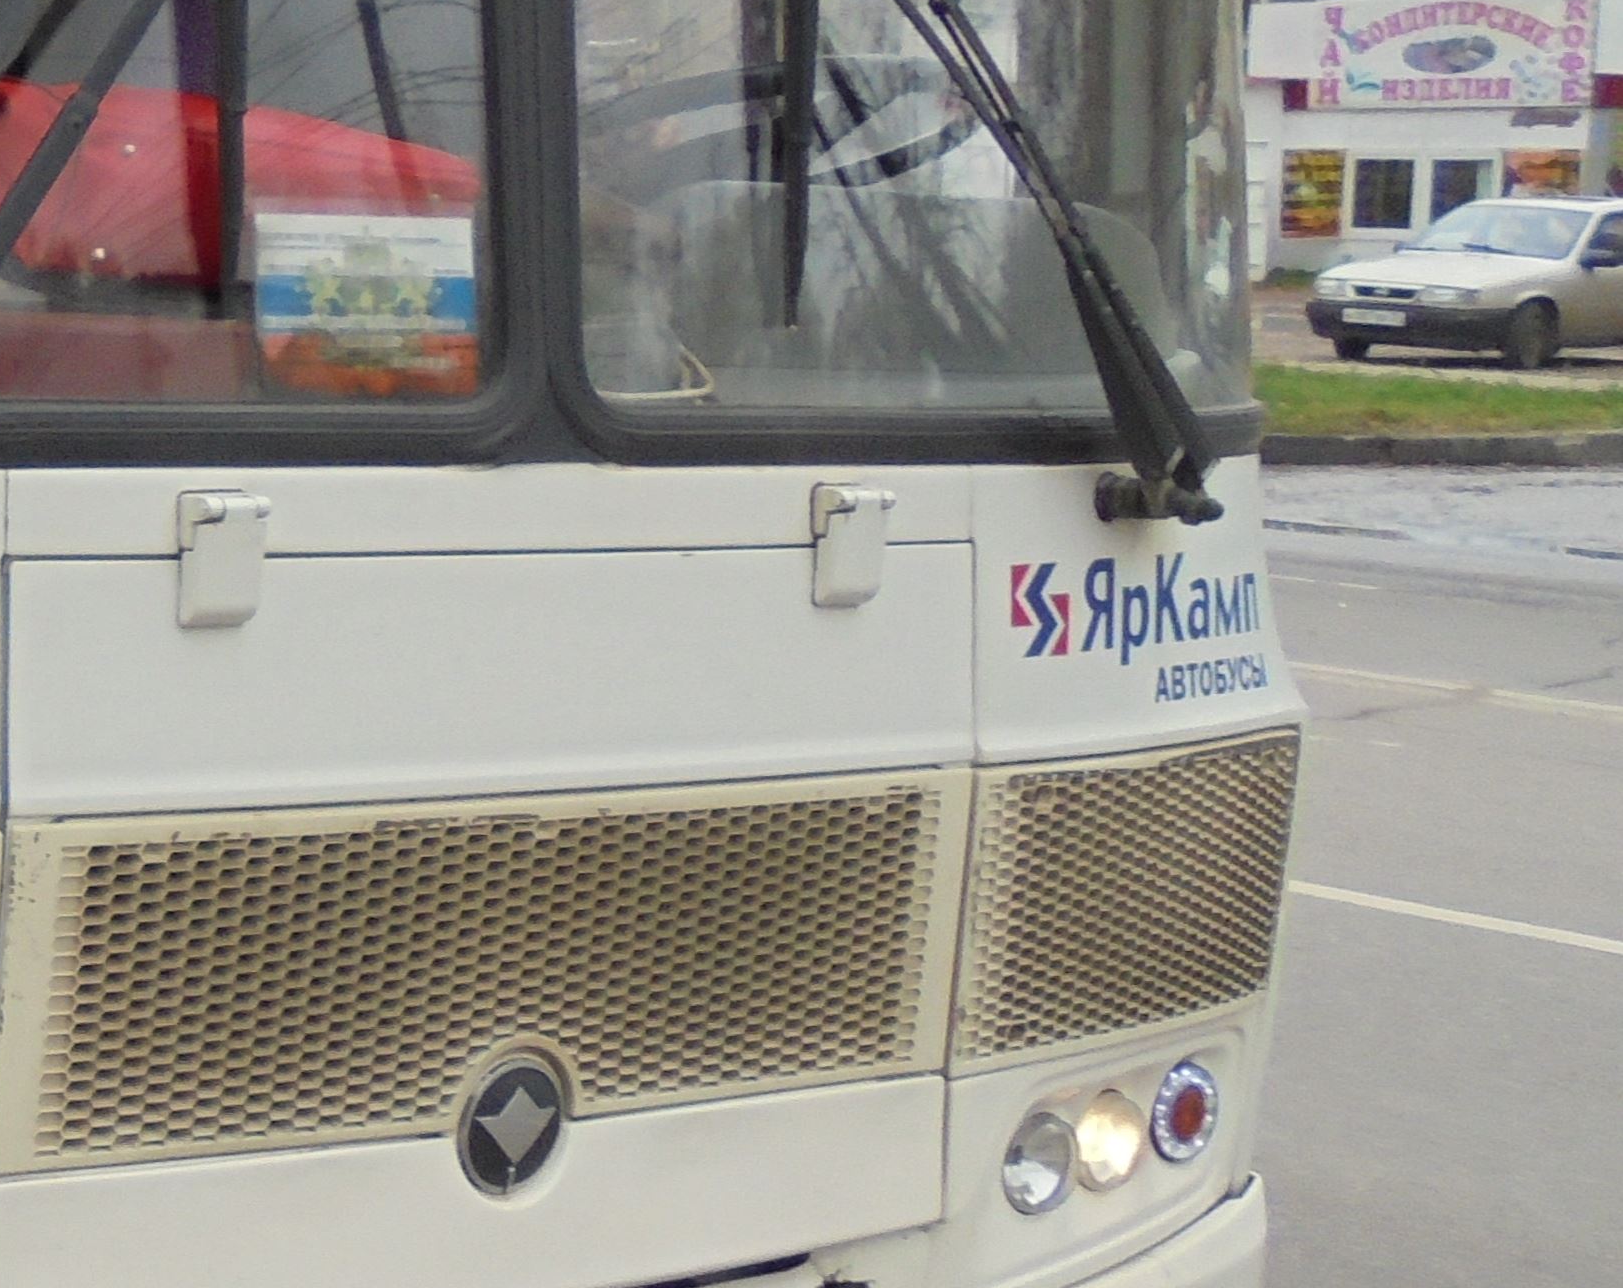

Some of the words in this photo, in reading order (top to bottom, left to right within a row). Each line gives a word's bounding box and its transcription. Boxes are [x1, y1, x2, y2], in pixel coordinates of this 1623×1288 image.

[1382, 77, 1512, 101] ИЗДЕЛИЯ
[1080, 552, 1262, 666] ЯрКамп
[1154, 653, 1269, 704] АВТОБУСЫ
